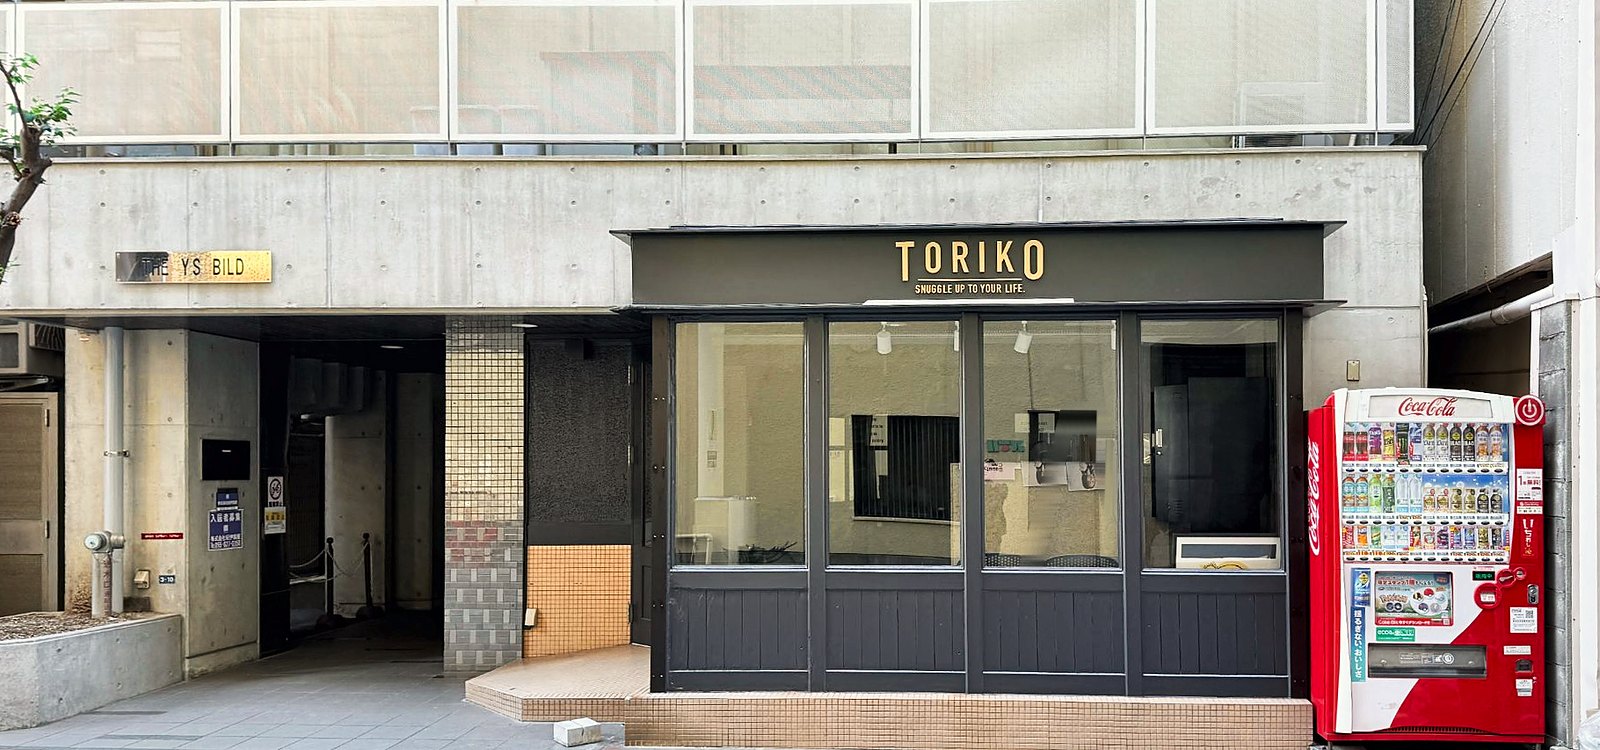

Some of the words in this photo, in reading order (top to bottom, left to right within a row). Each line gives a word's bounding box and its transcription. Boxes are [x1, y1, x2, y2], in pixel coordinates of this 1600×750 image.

[142, 256, 169, 276] THE
[181, 257, 201, 276] YS
[212, 257, 245, 276] BILD
[895, 239, 1044, 282] TORIKO
[914, 284, 953, 294] SNUGGLE
[955, 284, 966, 294] UP
[967, 284, 978, 294] TO
[979, 284, 1002, 294] YOUR
[1004, 284, 1026, 294] LIFE.
[1398, 396, 1459, 417] Coca-Cola
